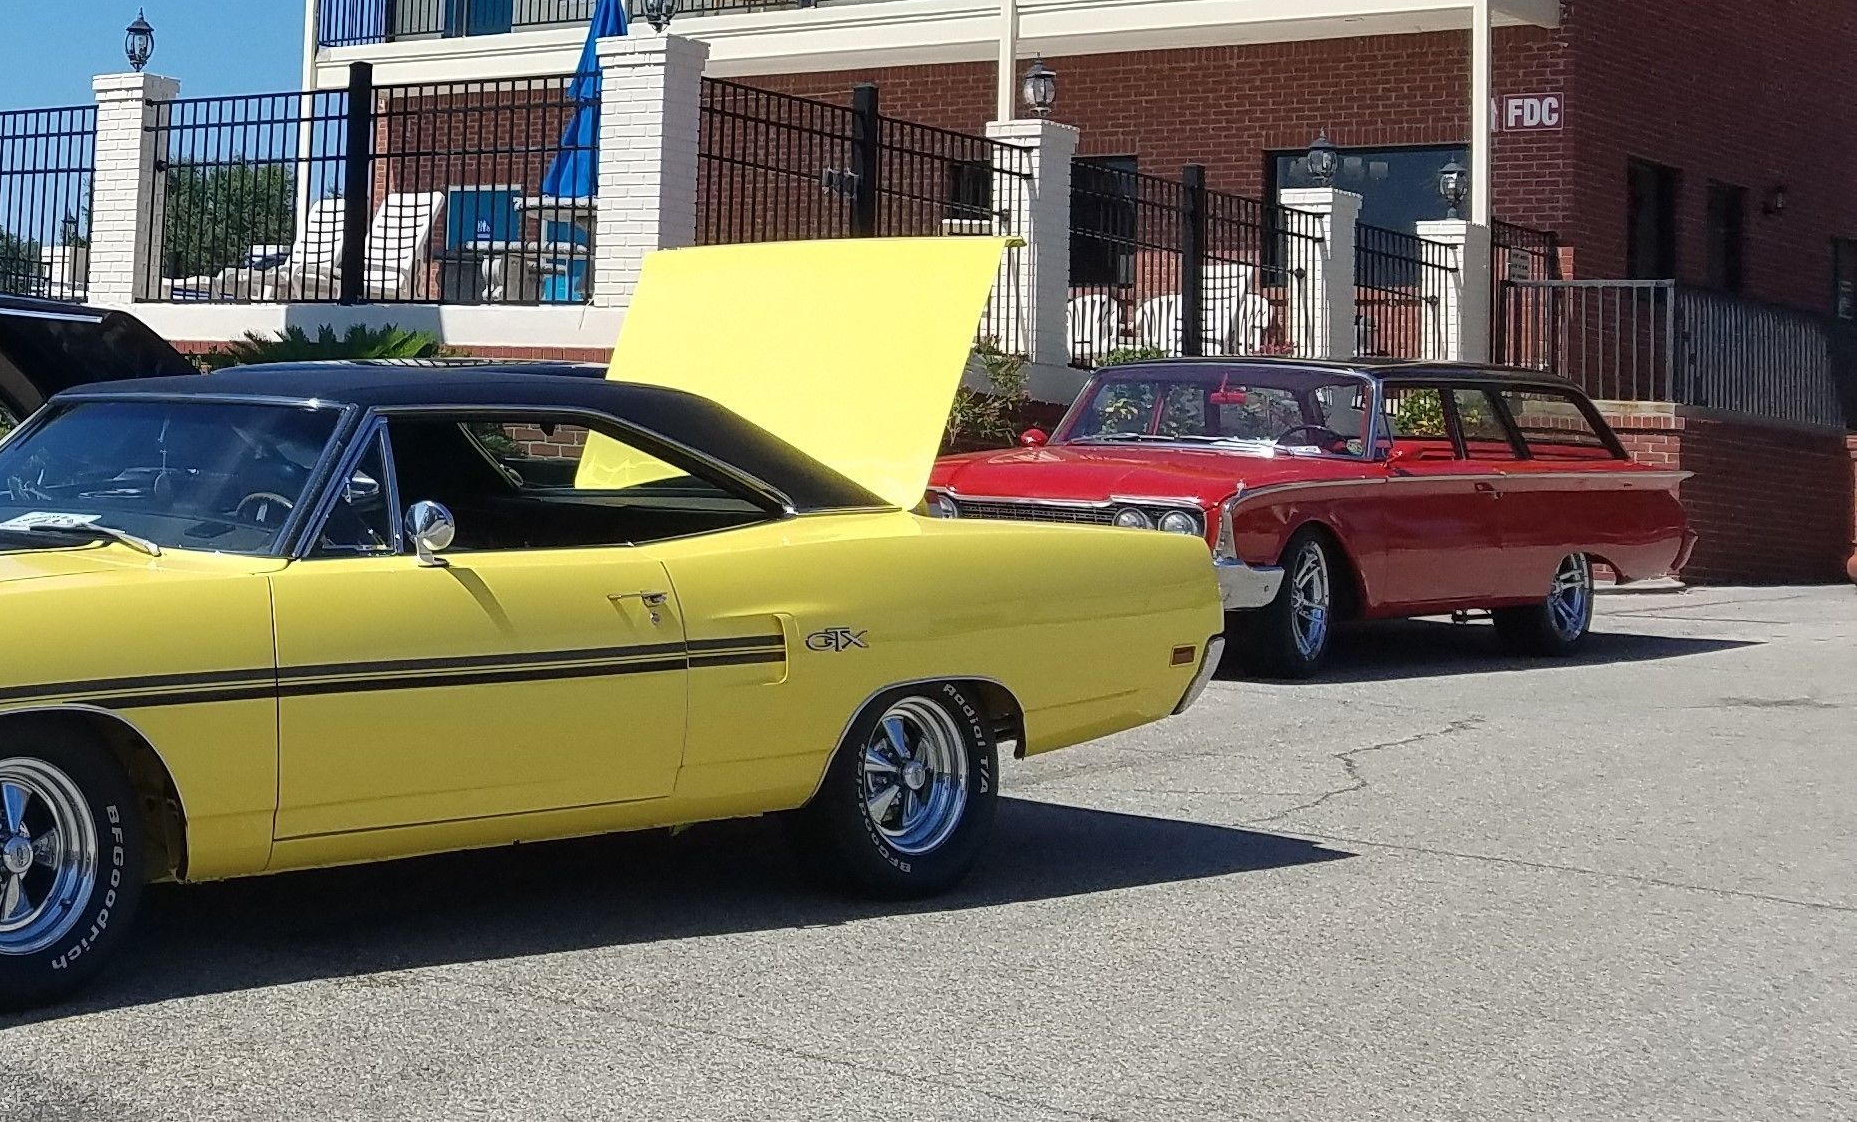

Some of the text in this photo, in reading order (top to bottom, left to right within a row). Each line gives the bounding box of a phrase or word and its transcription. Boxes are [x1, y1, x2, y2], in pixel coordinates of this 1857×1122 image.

[1507, 97, 1559, 128] FDC
[805, 626, 870, 652] GTX
[942, 683, 990, 794] Radial T/A
[51, 804, 125, 970] BFGoodrich
